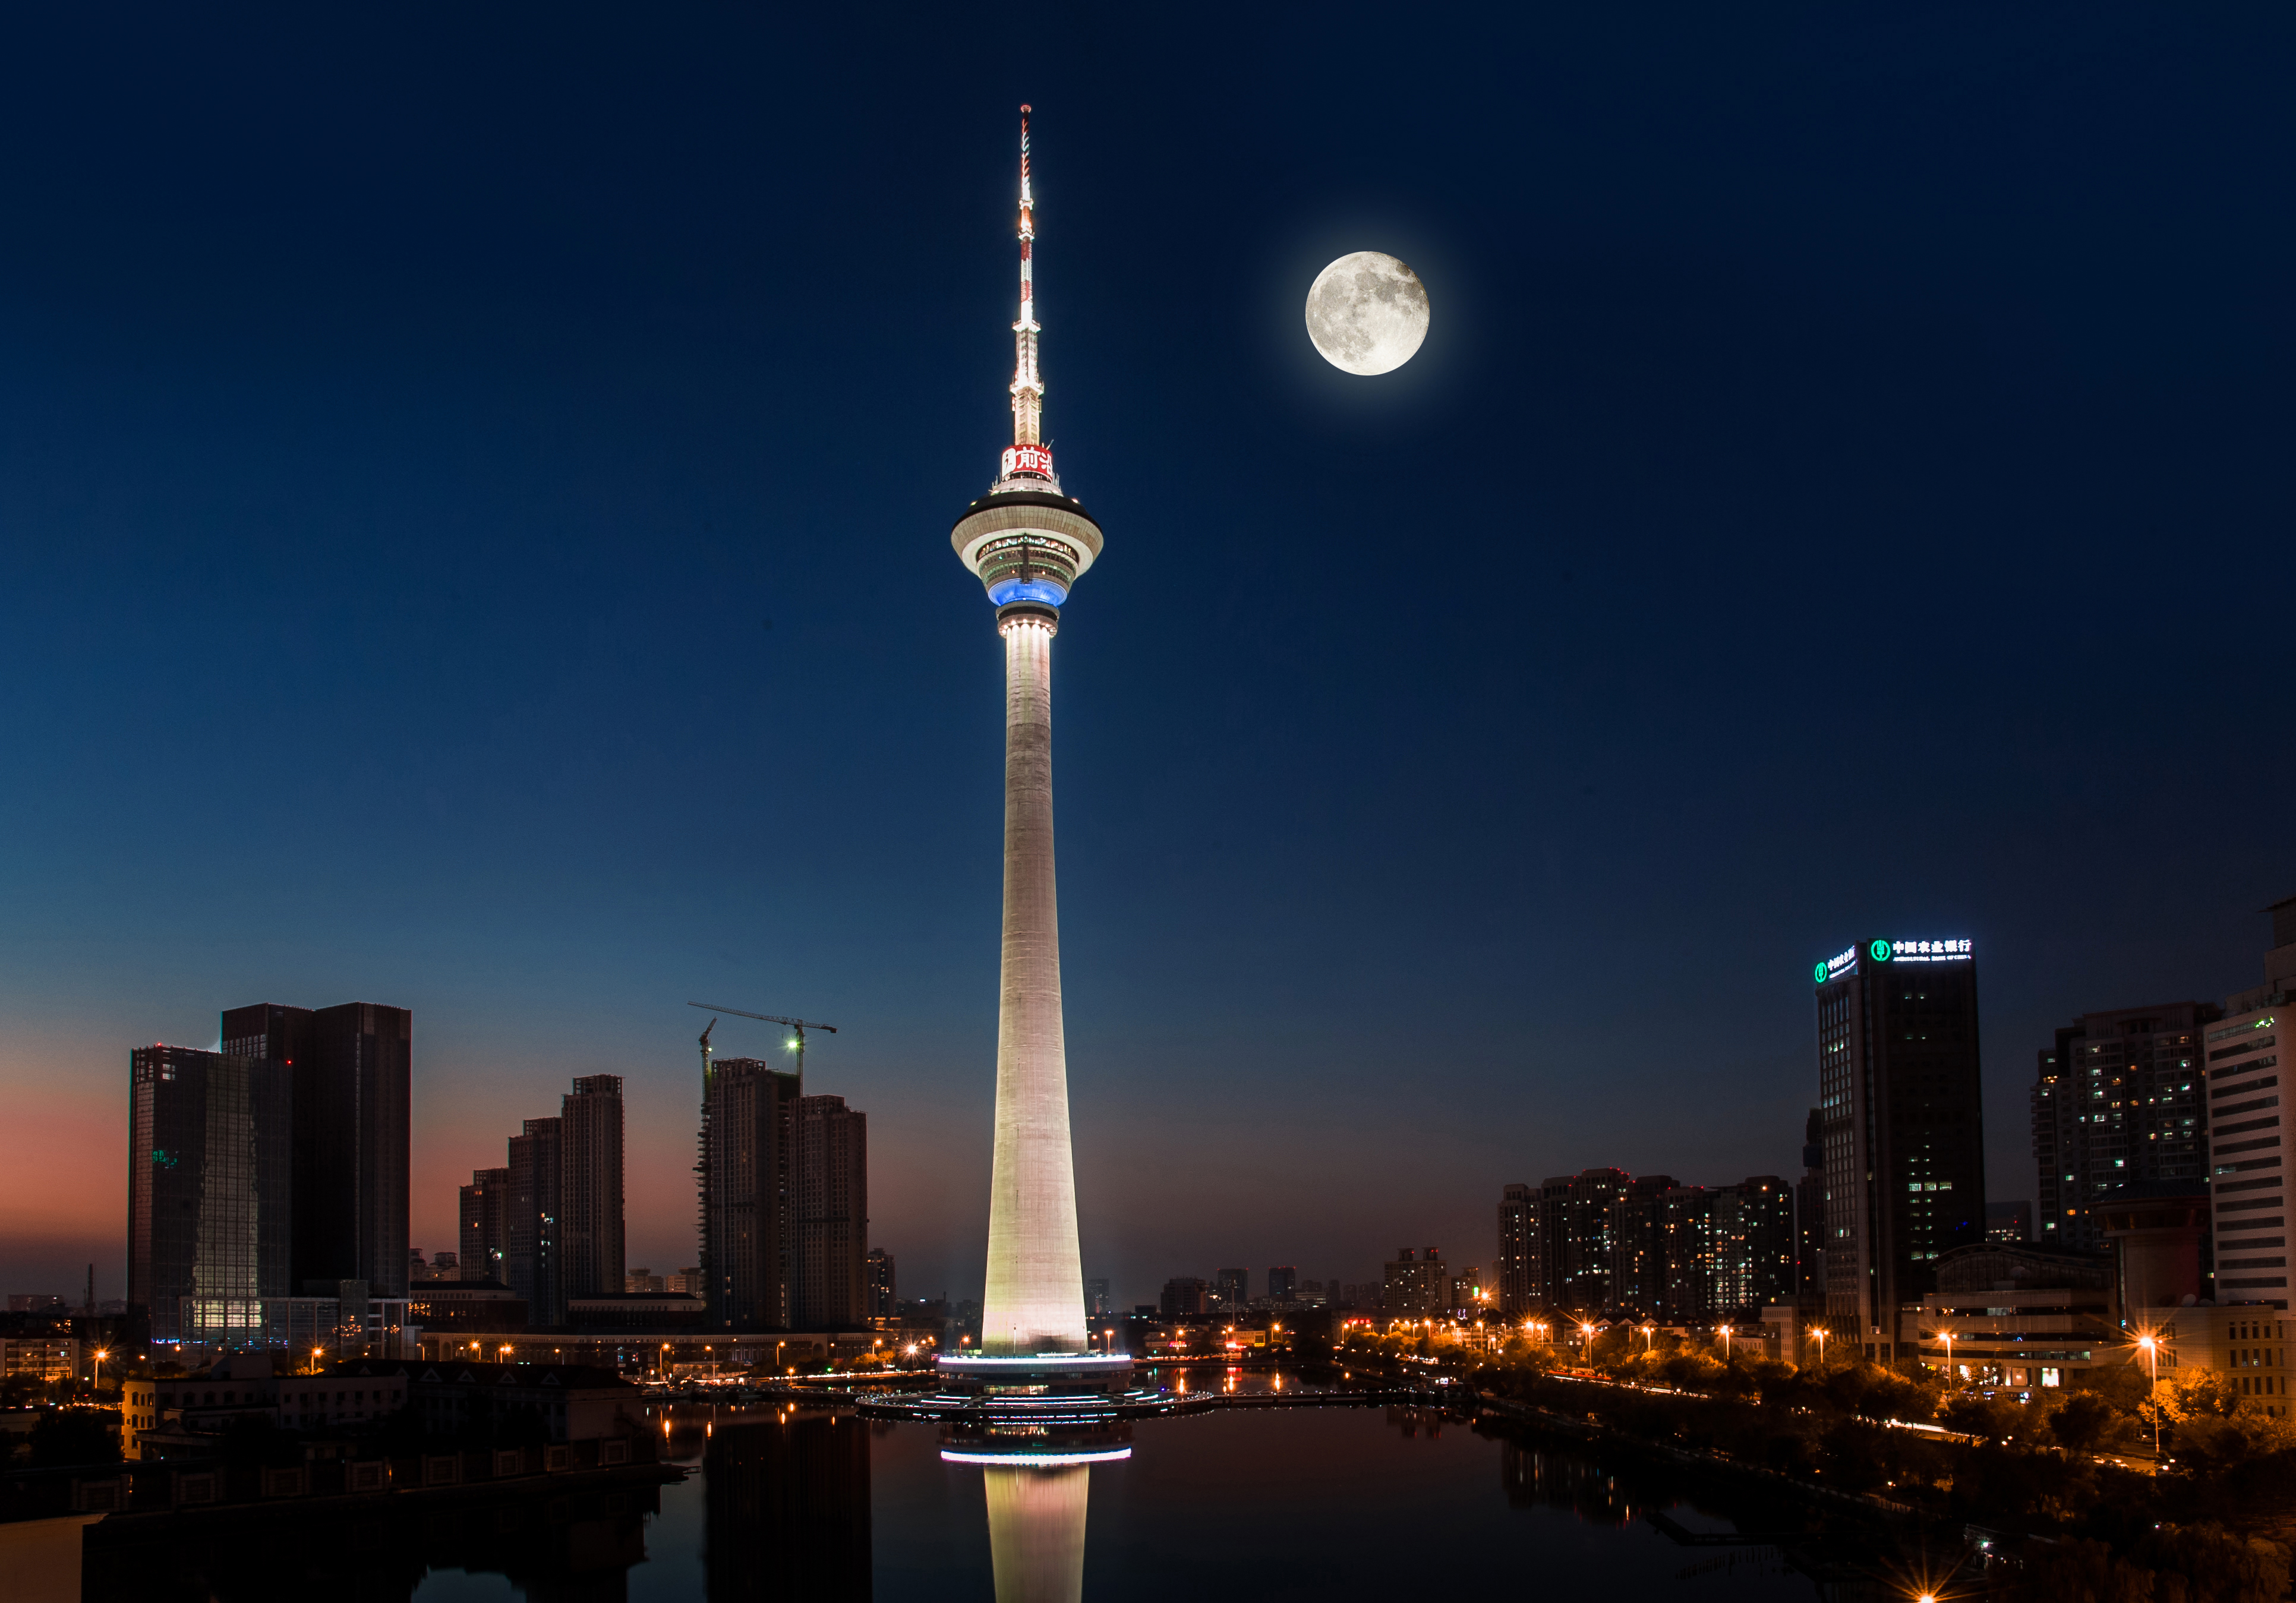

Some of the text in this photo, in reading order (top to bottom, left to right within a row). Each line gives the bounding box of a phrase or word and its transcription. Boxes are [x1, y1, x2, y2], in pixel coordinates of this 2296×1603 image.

[1893, 940, 1972, 954] 中国农业银行
